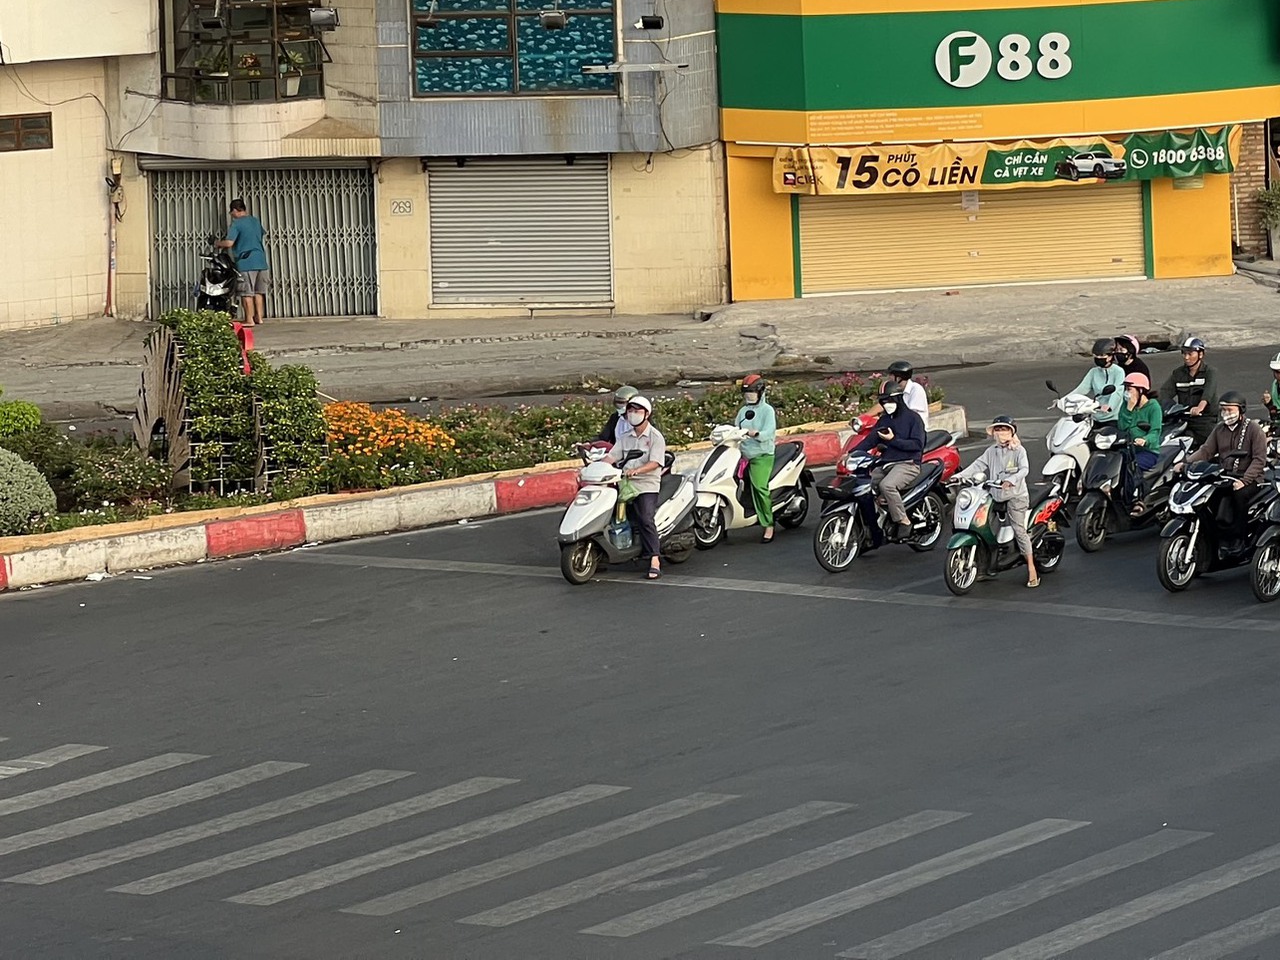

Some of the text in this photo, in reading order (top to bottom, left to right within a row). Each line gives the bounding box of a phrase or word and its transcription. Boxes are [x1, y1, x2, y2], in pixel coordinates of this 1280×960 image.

[1004, 154, 1022, 165] CHỈ
[1152, 145, 1225, 165] 1800 6388
[836, 155, 880, 189] 15
[887, 153, 917, 164] PHÚT
[882, 156, 979, 187] CÓ LIỀN
[993, 166, 1010, 178] CÀ
[1031, 166, 1044, 176] XE
[391, 200, 412, 214] 269
